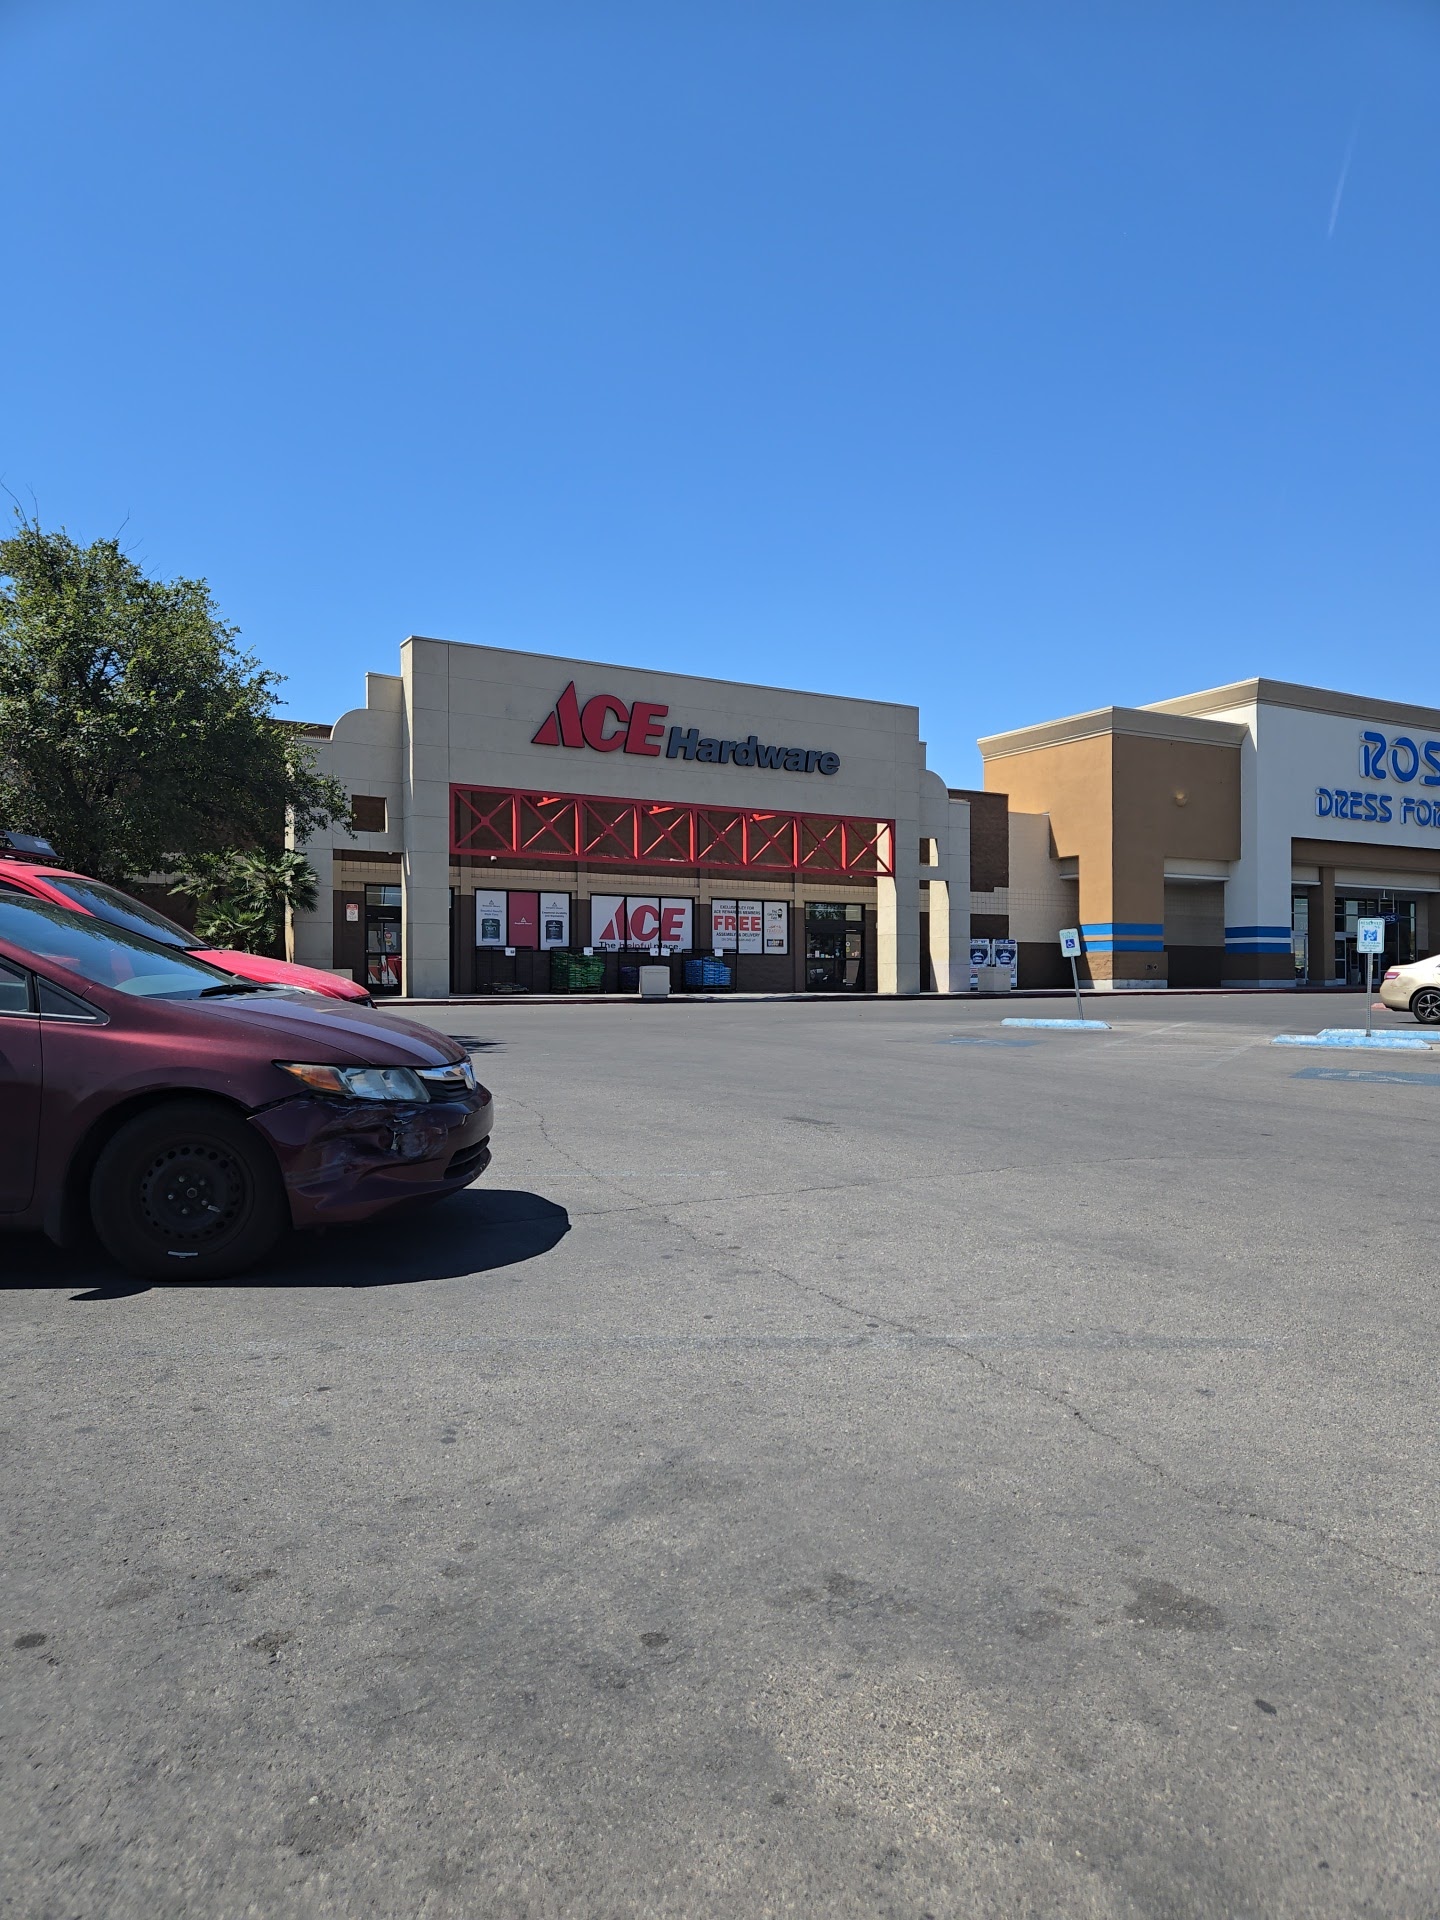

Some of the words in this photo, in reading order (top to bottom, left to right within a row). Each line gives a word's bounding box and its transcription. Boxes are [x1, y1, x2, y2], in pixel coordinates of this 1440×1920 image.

[531, 680, 669, 756] ACE
[665, 727, 840, 775] Hardware
[1315, 787, 1393, 823] DRESS
[599, 897, 686, 942] ACE
[714, 915, 761, 931] FREE
